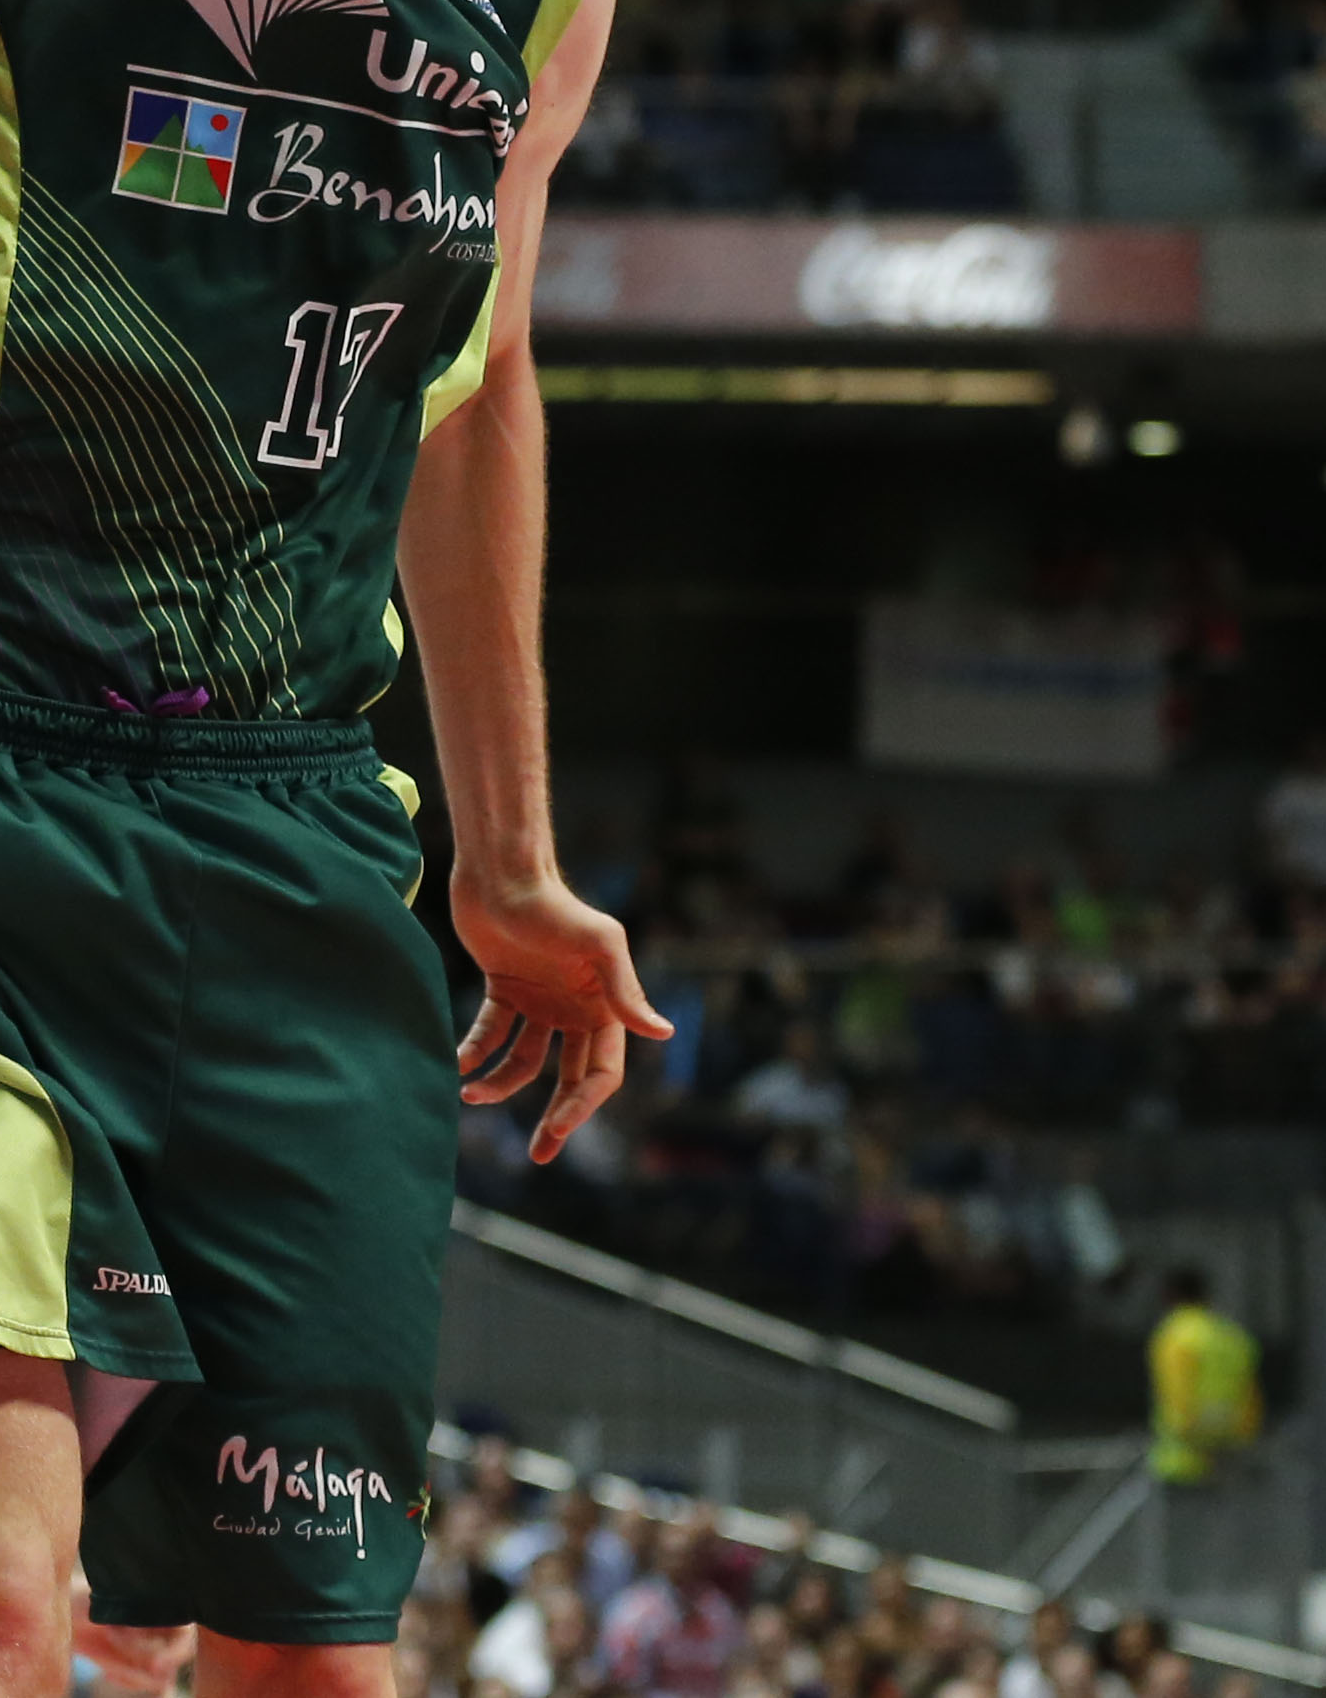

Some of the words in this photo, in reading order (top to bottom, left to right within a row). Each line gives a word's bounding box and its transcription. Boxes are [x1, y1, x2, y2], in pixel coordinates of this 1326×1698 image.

[257, 301, 405, 469] 17
[213, 1514, 281, 1537] Ciudad
[294, 1517, 351, 1541] Genial
